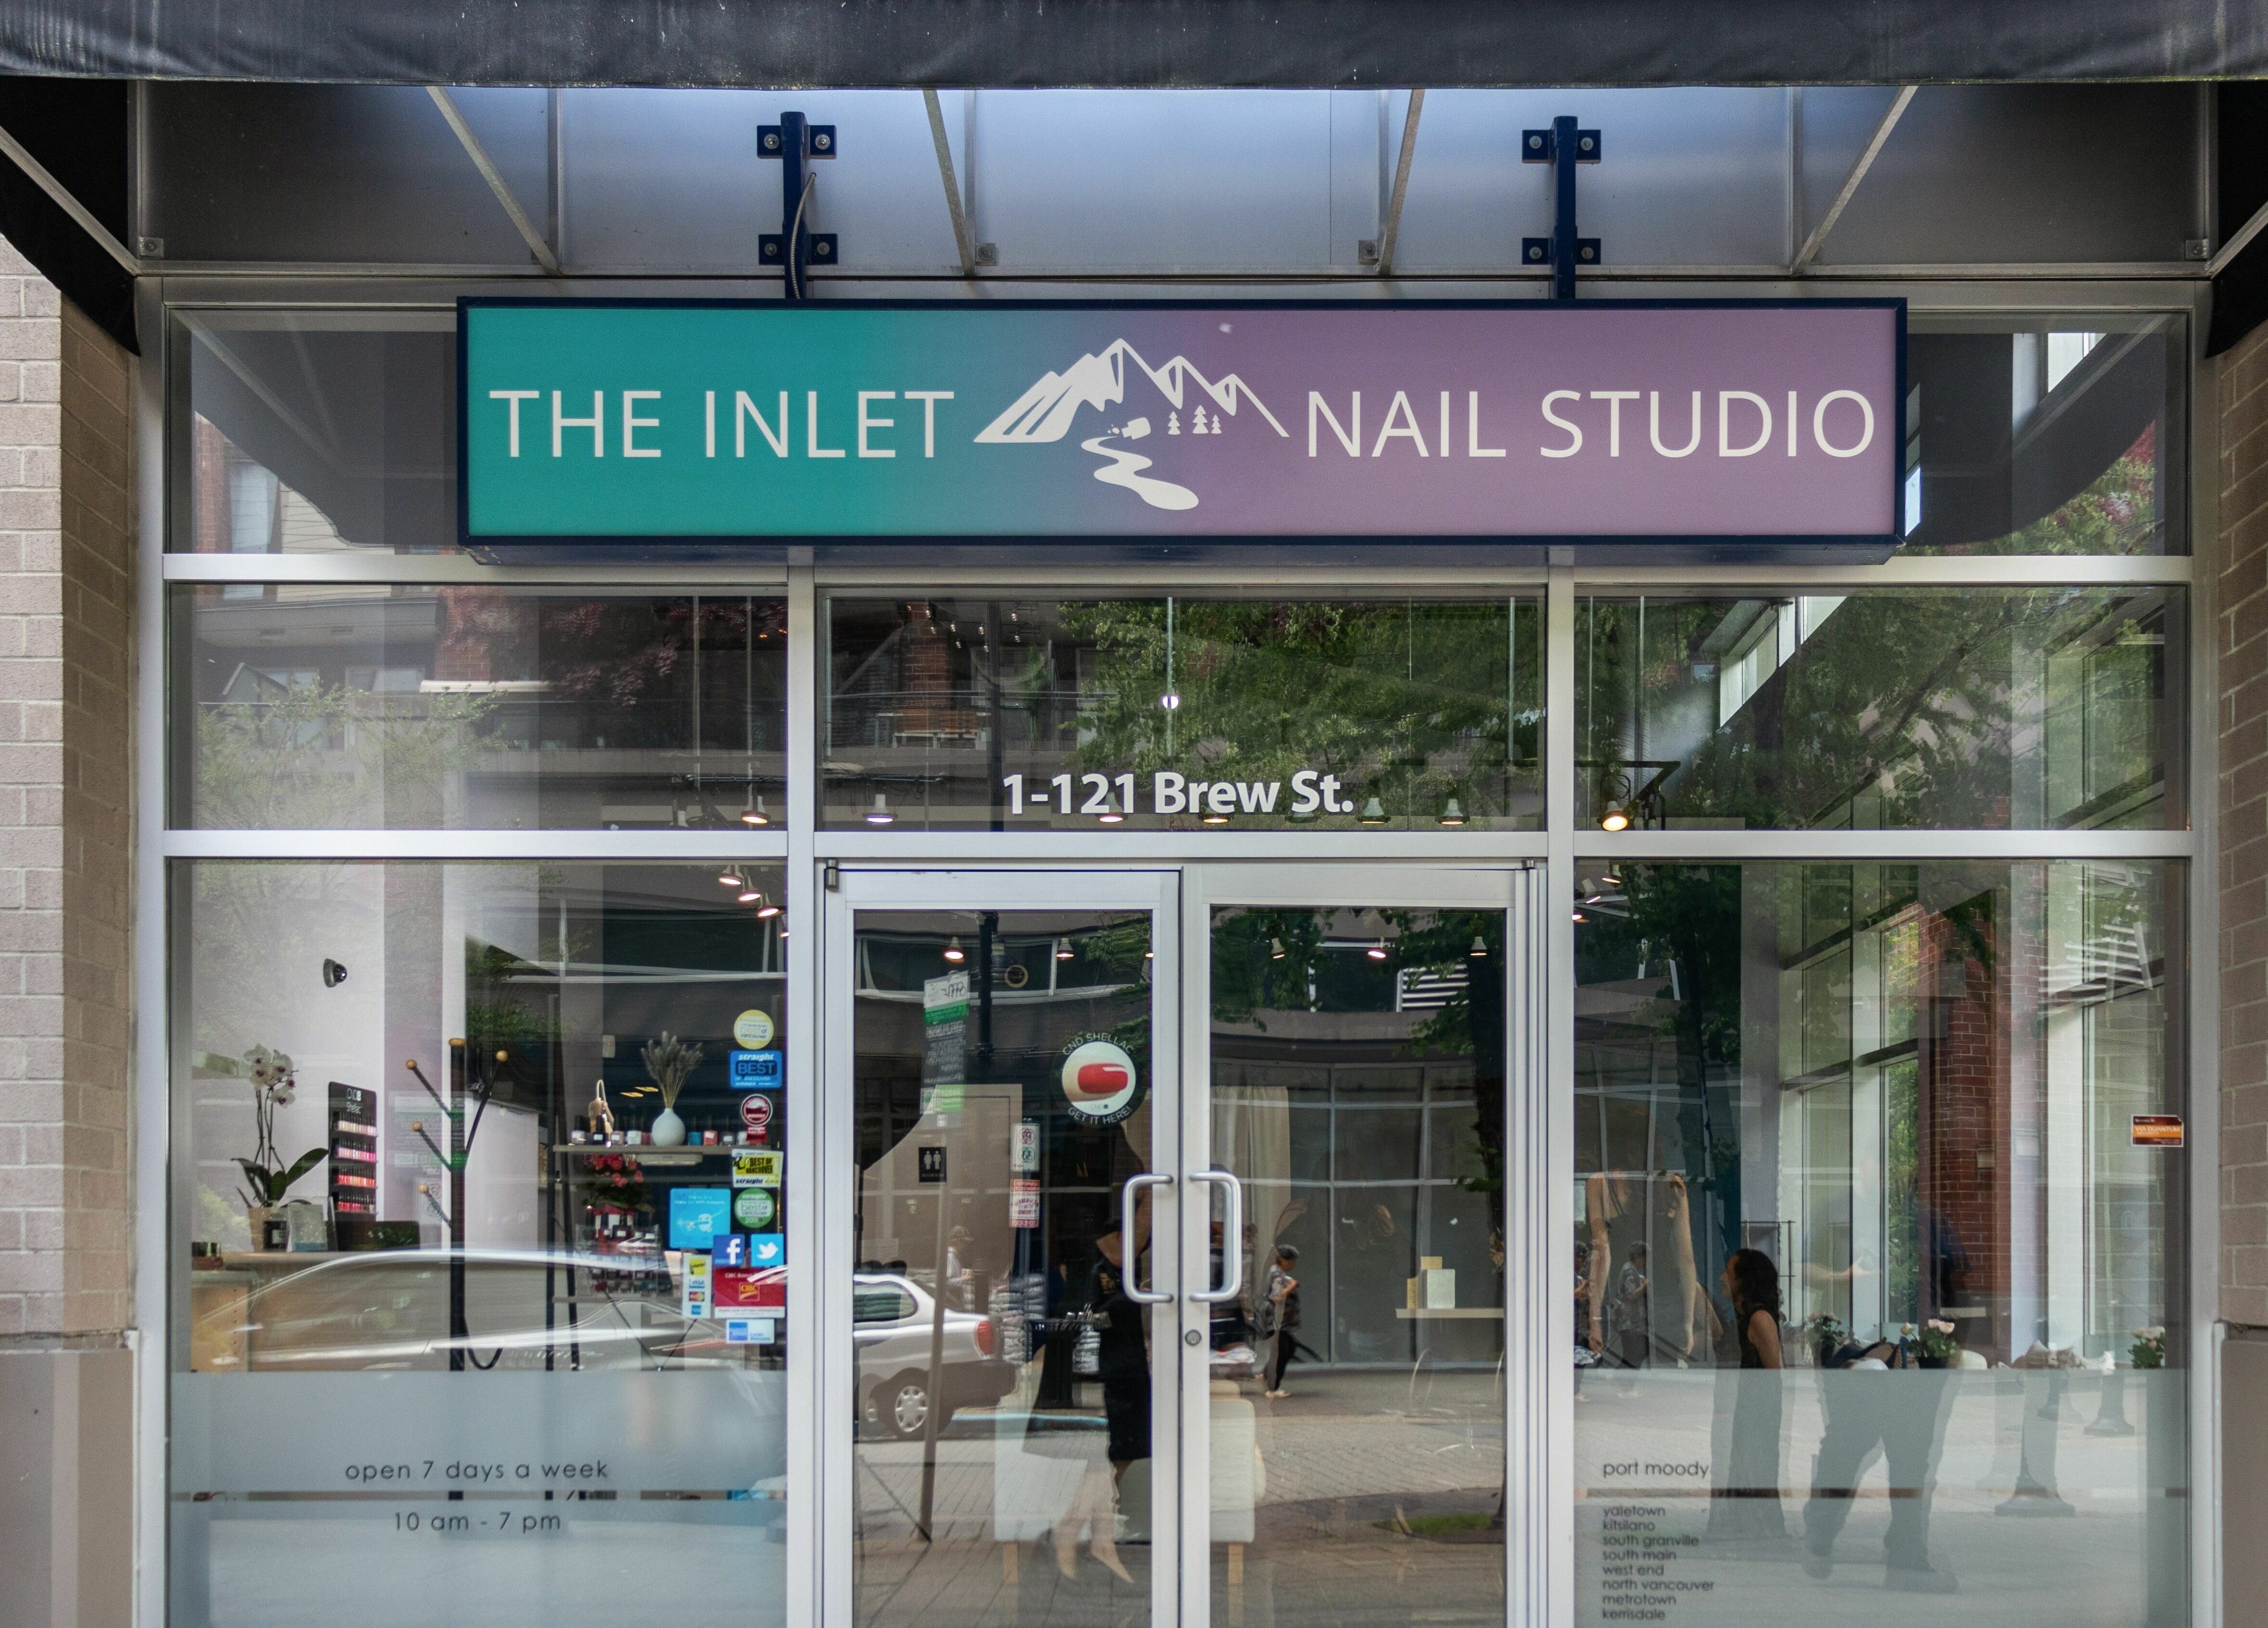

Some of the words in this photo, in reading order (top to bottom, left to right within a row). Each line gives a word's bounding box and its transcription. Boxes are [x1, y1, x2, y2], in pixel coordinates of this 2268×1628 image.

[490, 390, 661, 458] THE
[706, 390, 954, 458] INLET
[1308, 390, 1507, 458] NAIL
[1540, 389, 1875, 459] STUDIO
[1003, 773, 1135, 815] 1-121
[1155, 773, 1280, 814] Brew
[1291, 771, 1354, 813] St.
[1086, 1033, 1134, 1054] SHELLAC
[738, 1053, 774, 1062] straight
[738, 1062, 775, 1075] BEST
[1067, 1107, 1089, 1122] GET
[1090, 1116, 1099, 1125] IT
[1102, 1105, 1132, 1125] HERE!
[750, 1157, 765, 1167] BEST
[346, 1464, 410, 1484] open
[423, 1460, 434, 1479] 7
[445, 1460, 504, 1483] days
[515, 1464, 530, 1479] a
[541, 1460, 608, 1479] week
[1603, 1460, 1639, 1479] port
[1645, 1461, 1710, 1480] moody
[1602, 1506, 1666, 1519] yaletown
[395, 1512, 420, 1531] 10
[431, 1515, 469, 1531] am
[499, 1512, 511, 1531] 7
[522, 1515, 561, 1534] pm
[1602, 1519, 1656, 1532] kitsilano
[1602, 1534, 1639, 1546] south
[1642, 1534, 1700, 1548] granville
[1602, 1549, 1639, 1561] south
[1642, 1549, 1677, 1561] main
[1602, 1564, 1634, 1576] west
[1637, 1563, 1664, 1576] end
[1602, 1578, 1637, 1590] north
[1641, 1581, 1715, 1591] vancouver
[1602, 1593, 1677, 1606] metrotown
[1602, 1607, 1666, 1621] kerrisdale
